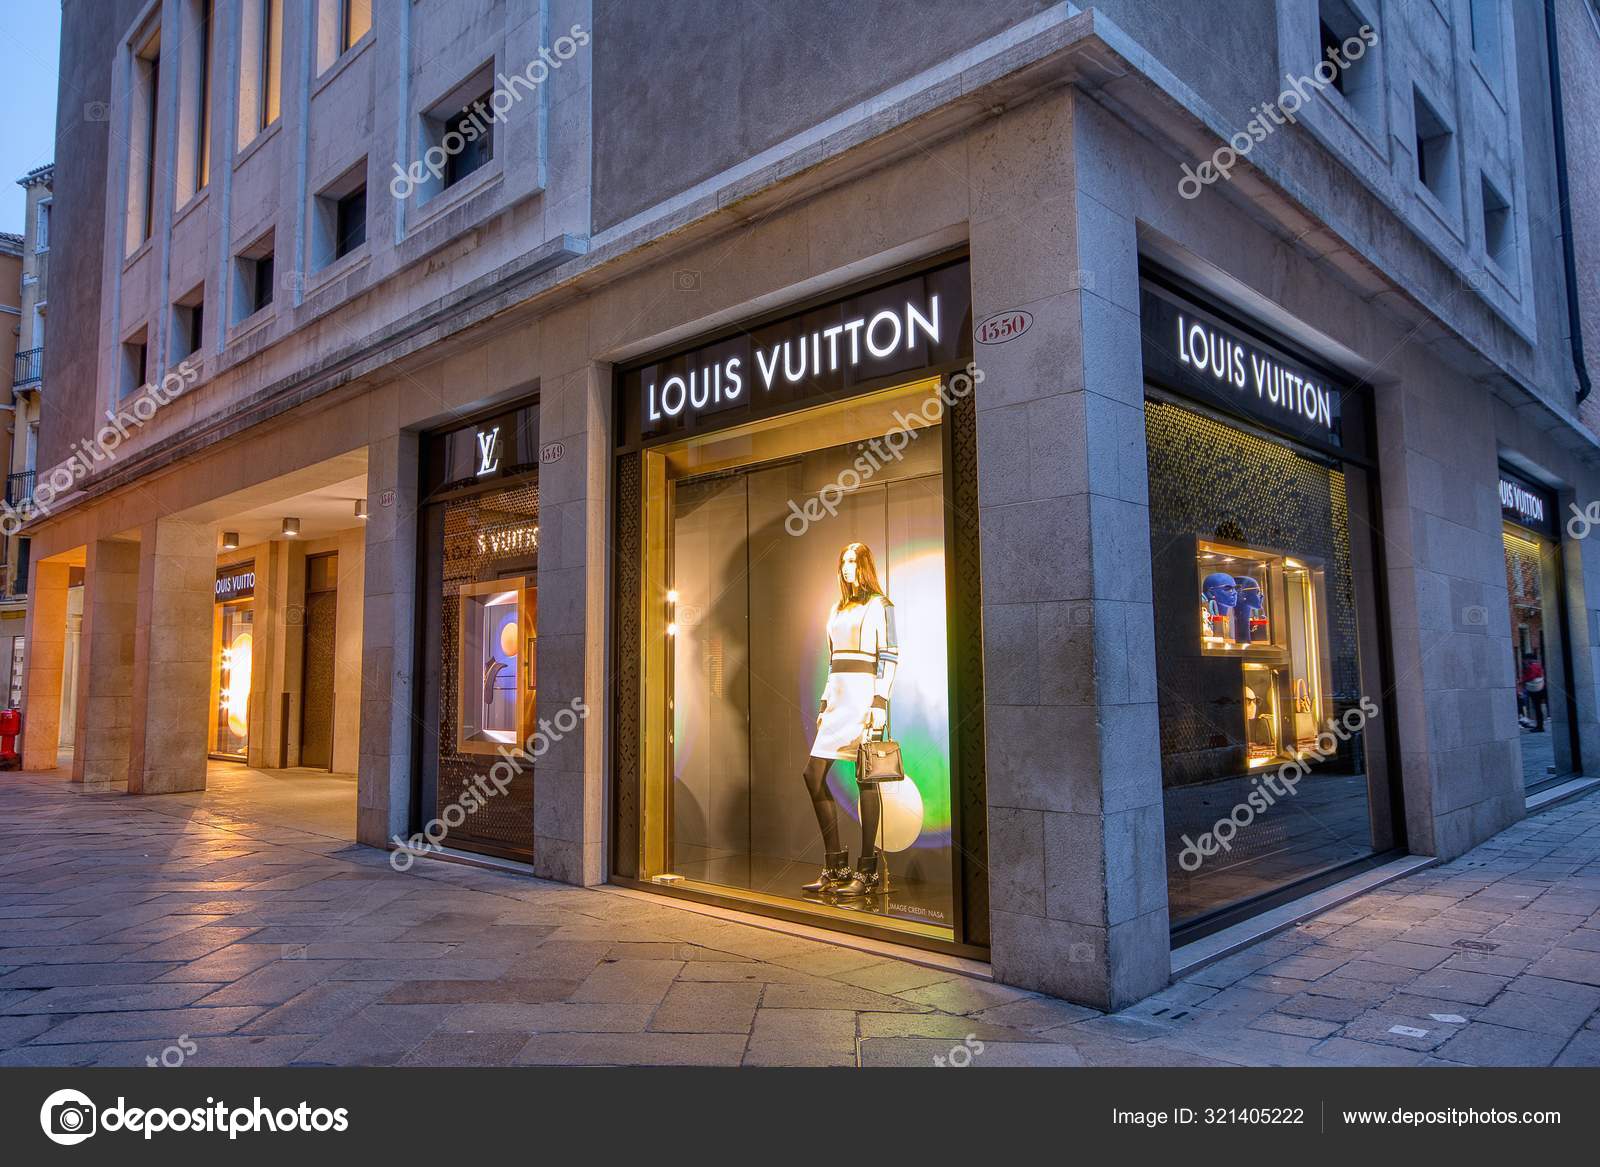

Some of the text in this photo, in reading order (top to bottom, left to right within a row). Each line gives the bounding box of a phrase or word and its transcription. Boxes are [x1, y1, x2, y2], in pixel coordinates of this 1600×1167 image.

[649, 295, 940, 421] LOUIS VUITTON
[1178, 316, 1331, 429] LOUIS VUITTON
[1513, 486, 1544, 522] VUITTON
[215, 572, 256, 594] OUIS VUITTO
[889, 903, 907, 913] IMAGE
[928, 910, 944, 919] NASA
